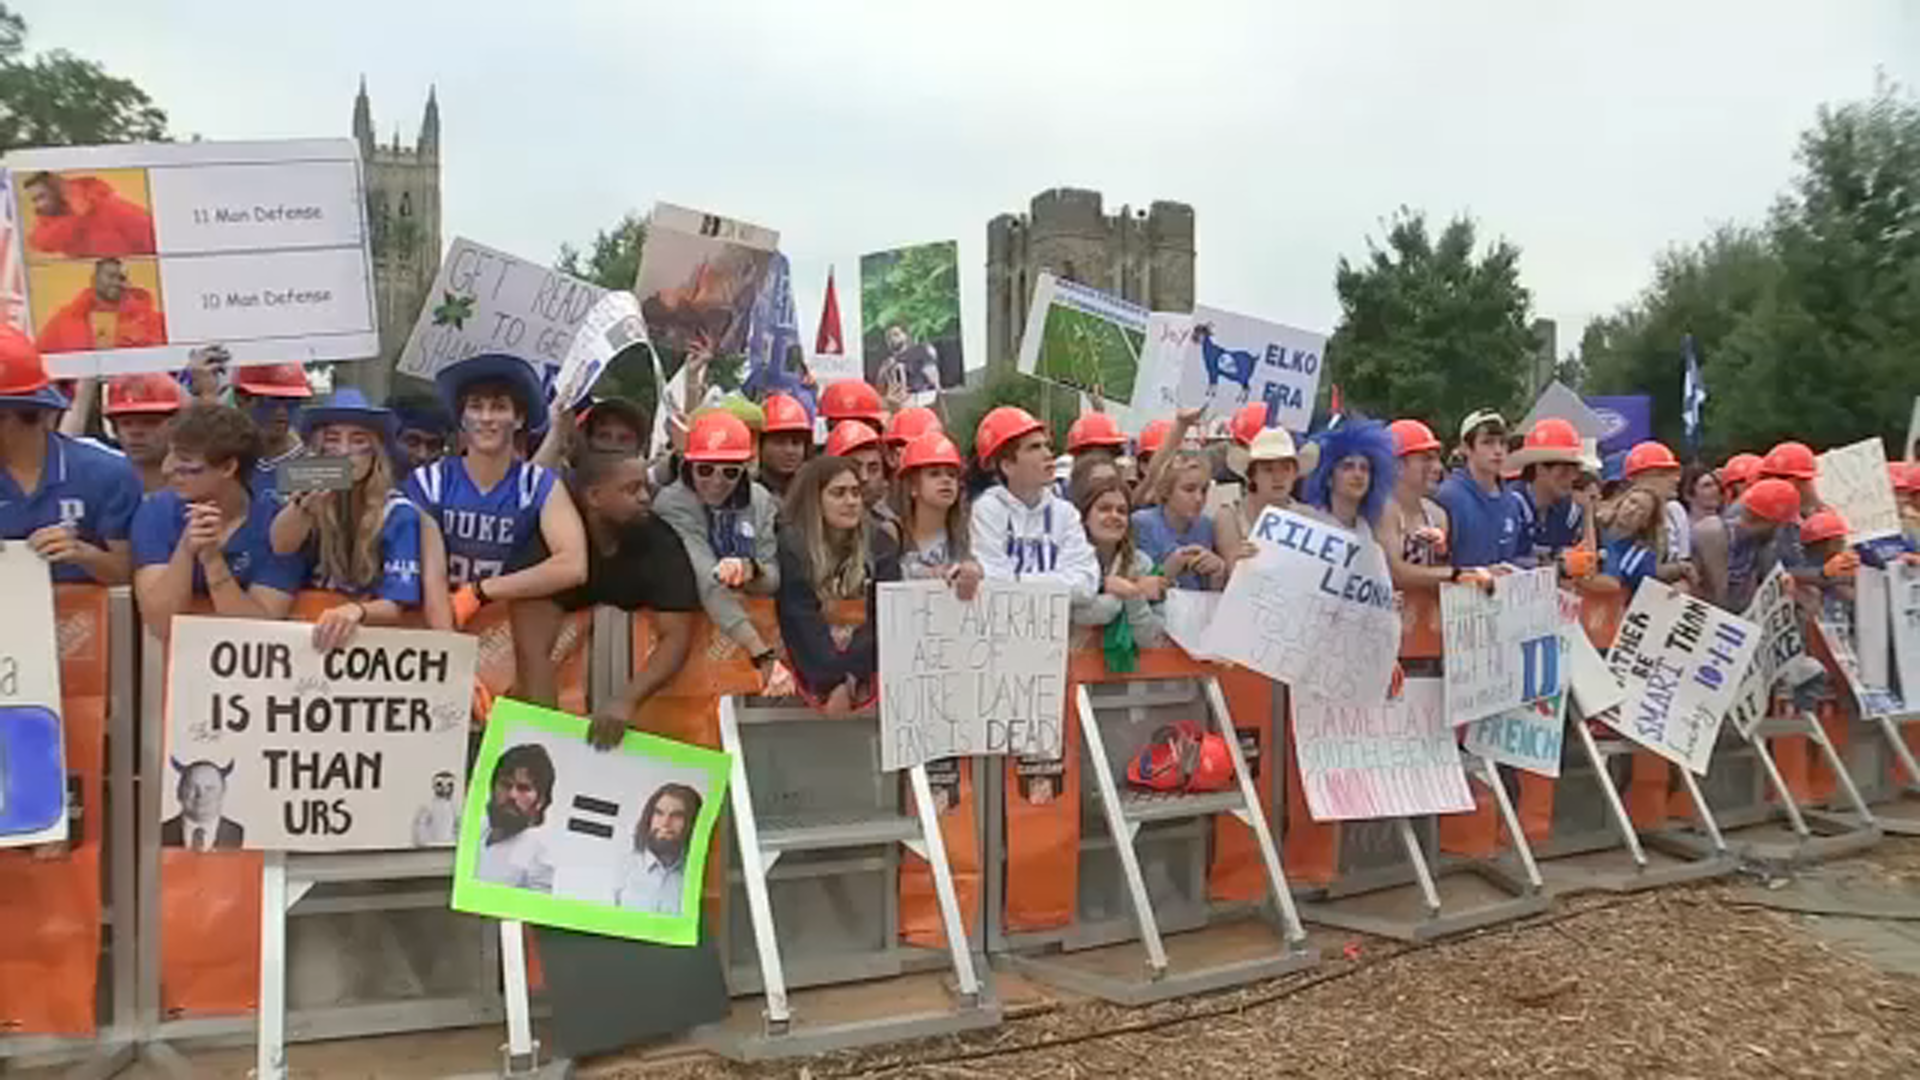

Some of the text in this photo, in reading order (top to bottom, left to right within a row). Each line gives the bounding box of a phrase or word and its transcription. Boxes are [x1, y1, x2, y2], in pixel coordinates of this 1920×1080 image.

[193, 204, 324, 224] 11 Man Defense
[450, 248, 517, 301] GET
[201, 288, 333, 310] 10 Man Defense
[492, 311, 573, 360] TO GE
[1264, 343, 1318, 376] ELKO
[1263, 380, 1303, 409] ERA
[443, 509, 514, 545] DUKE
[1256, 512, 1361, 569] RILEY
[960, 590, 1069, 641] AVERAGE
[210, 641, 449, 682] OUR COACH
[1609, 611, 1651, 689] ATHER
[1635, 599, 1710, 743] SMART THAN
[211, 693, 251, 733] IS
[266, 697, 432, 733] HOTTER
[884, 671, 1056, 724] NOTRE DAME
[986, 718, 1060, 753] DEAD
[262, 750, 382, 790] THAN
[284, 799, 352, 835] URS
